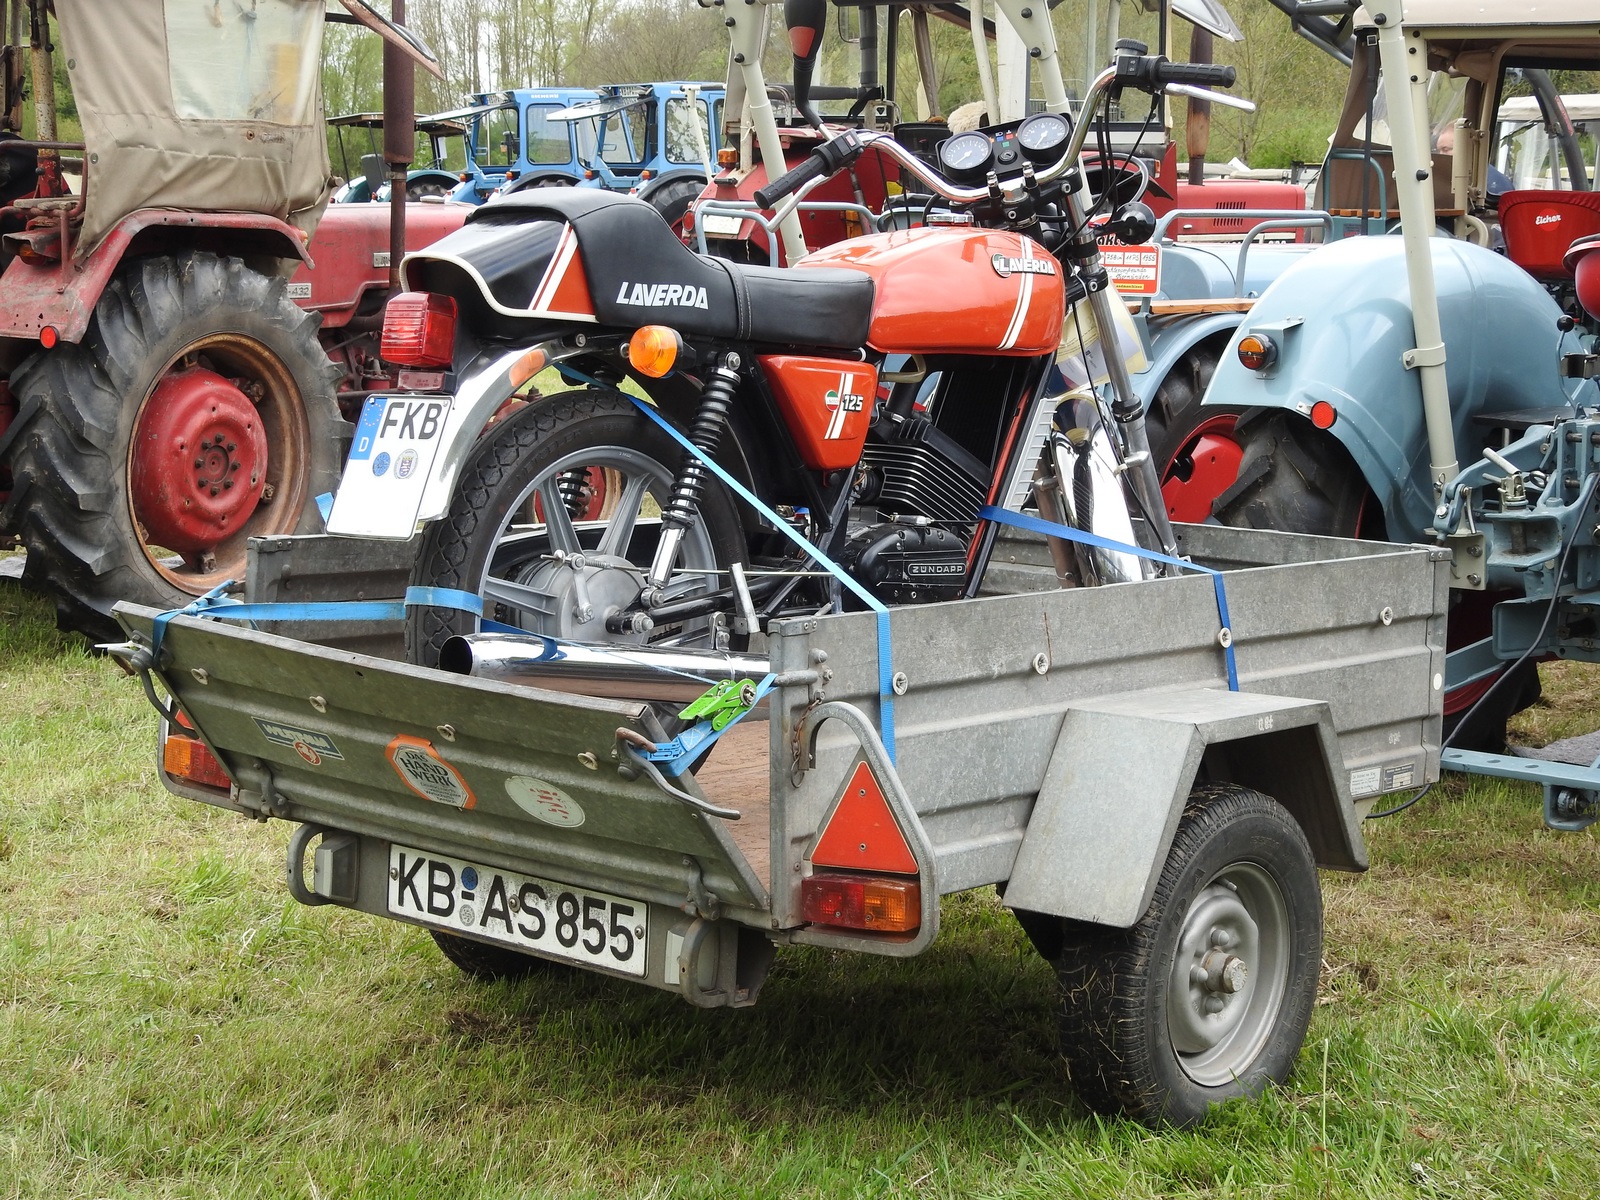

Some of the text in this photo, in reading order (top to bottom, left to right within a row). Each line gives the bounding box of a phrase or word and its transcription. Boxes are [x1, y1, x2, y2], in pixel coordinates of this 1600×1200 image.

[1535, 214, 1562, 225] Eicher
[999, 256, 1056, 276] LAVERDA
[616, 281, 709, 310] LAVERDA
[843, 394, 864, 411] 125
[379, 402, 442, 440] FKB
[358, 437, 369, 452] D
[912, 565, 964, 574] ZÜNDAPP
[405, 751, 429, 762] DAS
[400, 757, 449, 776] HAND
[407, 768, 457, 788] WERK
[555, 892, 635, 962] 855
